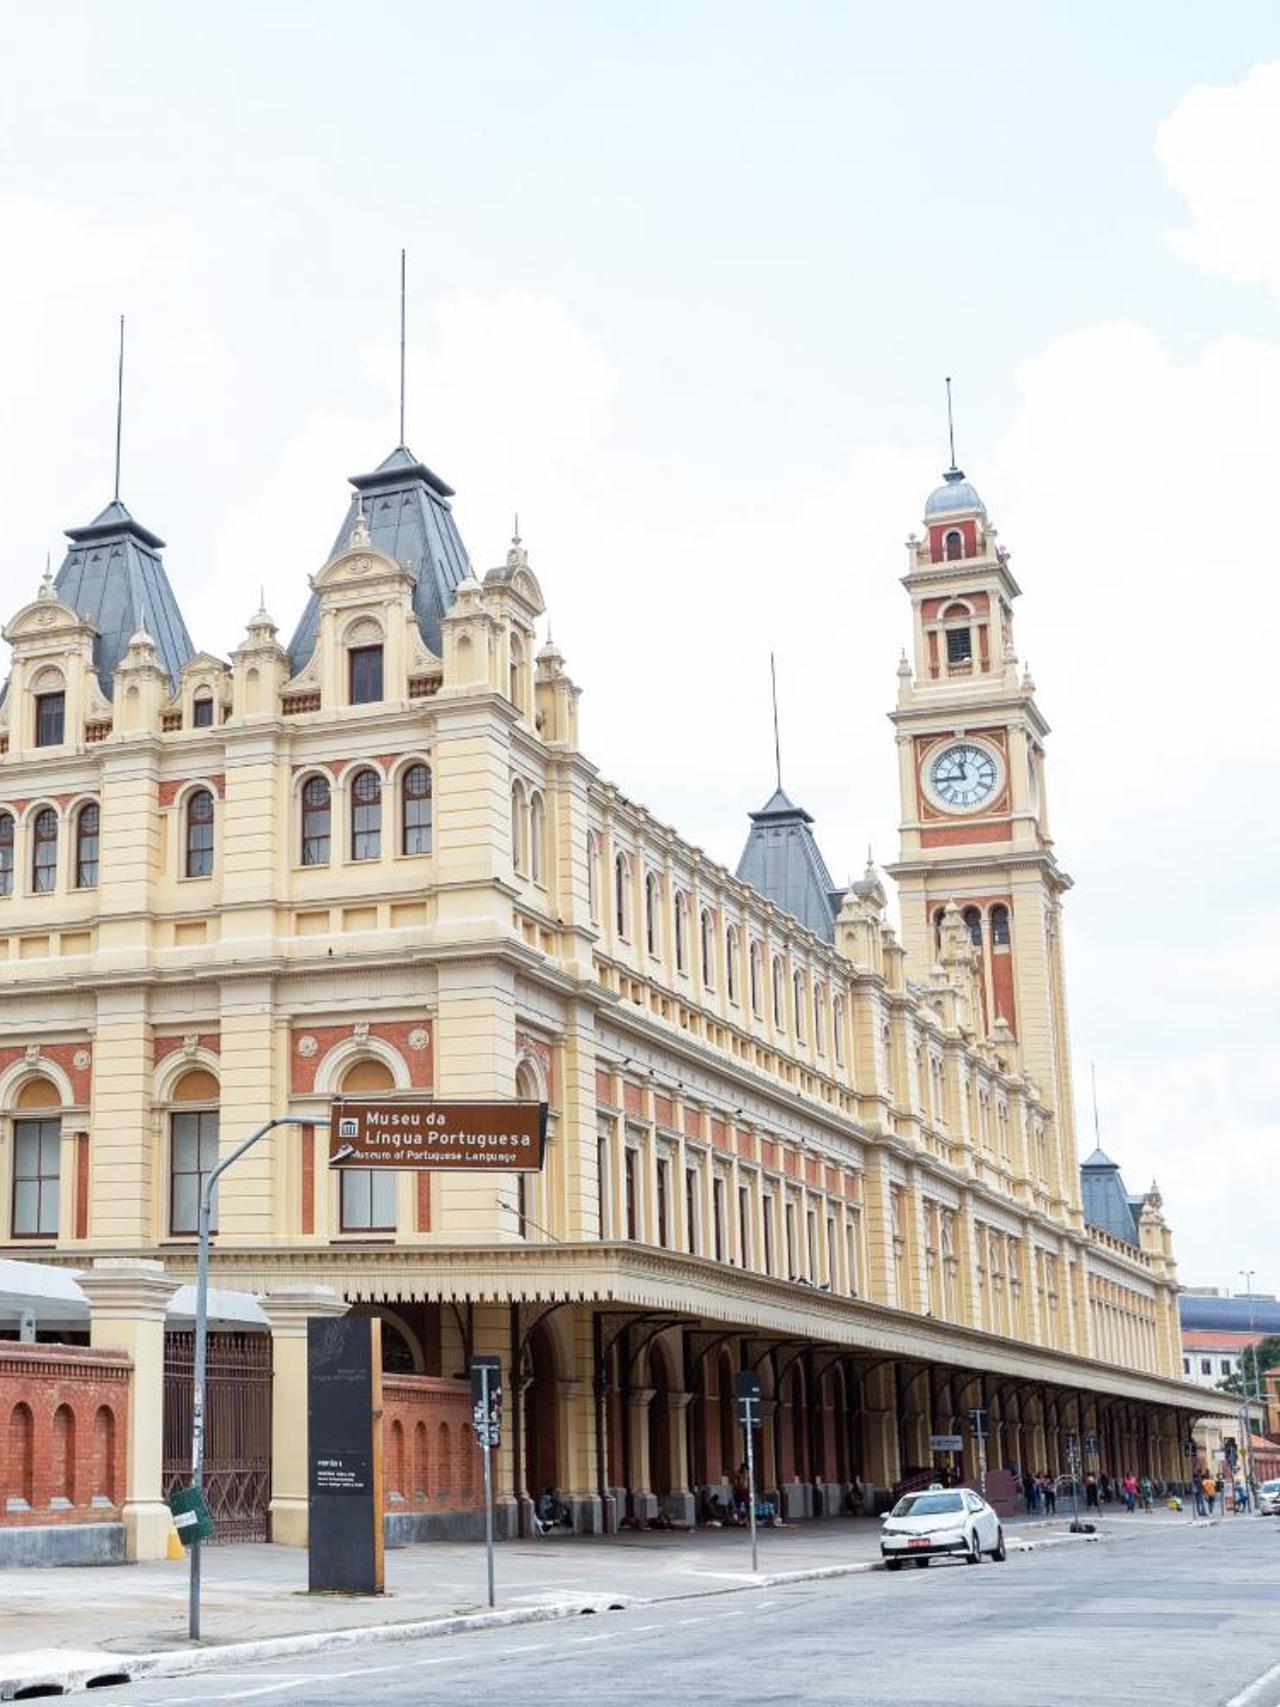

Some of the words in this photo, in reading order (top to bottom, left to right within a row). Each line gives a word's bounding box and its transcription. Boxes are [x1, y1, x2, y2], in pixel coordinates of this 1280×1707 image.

[366, 1112, 420, 1126] Museu
[426, 1112, 446, 1126] da
[365, 1130, 422, 1146] Língua
[428, 1131, 531, 1148] Portuguesa
[394, 1150, 405, 1160] of
[407, 1150, 462, 1161] Portuguese
[465, 1151, 517, 1163] Language
